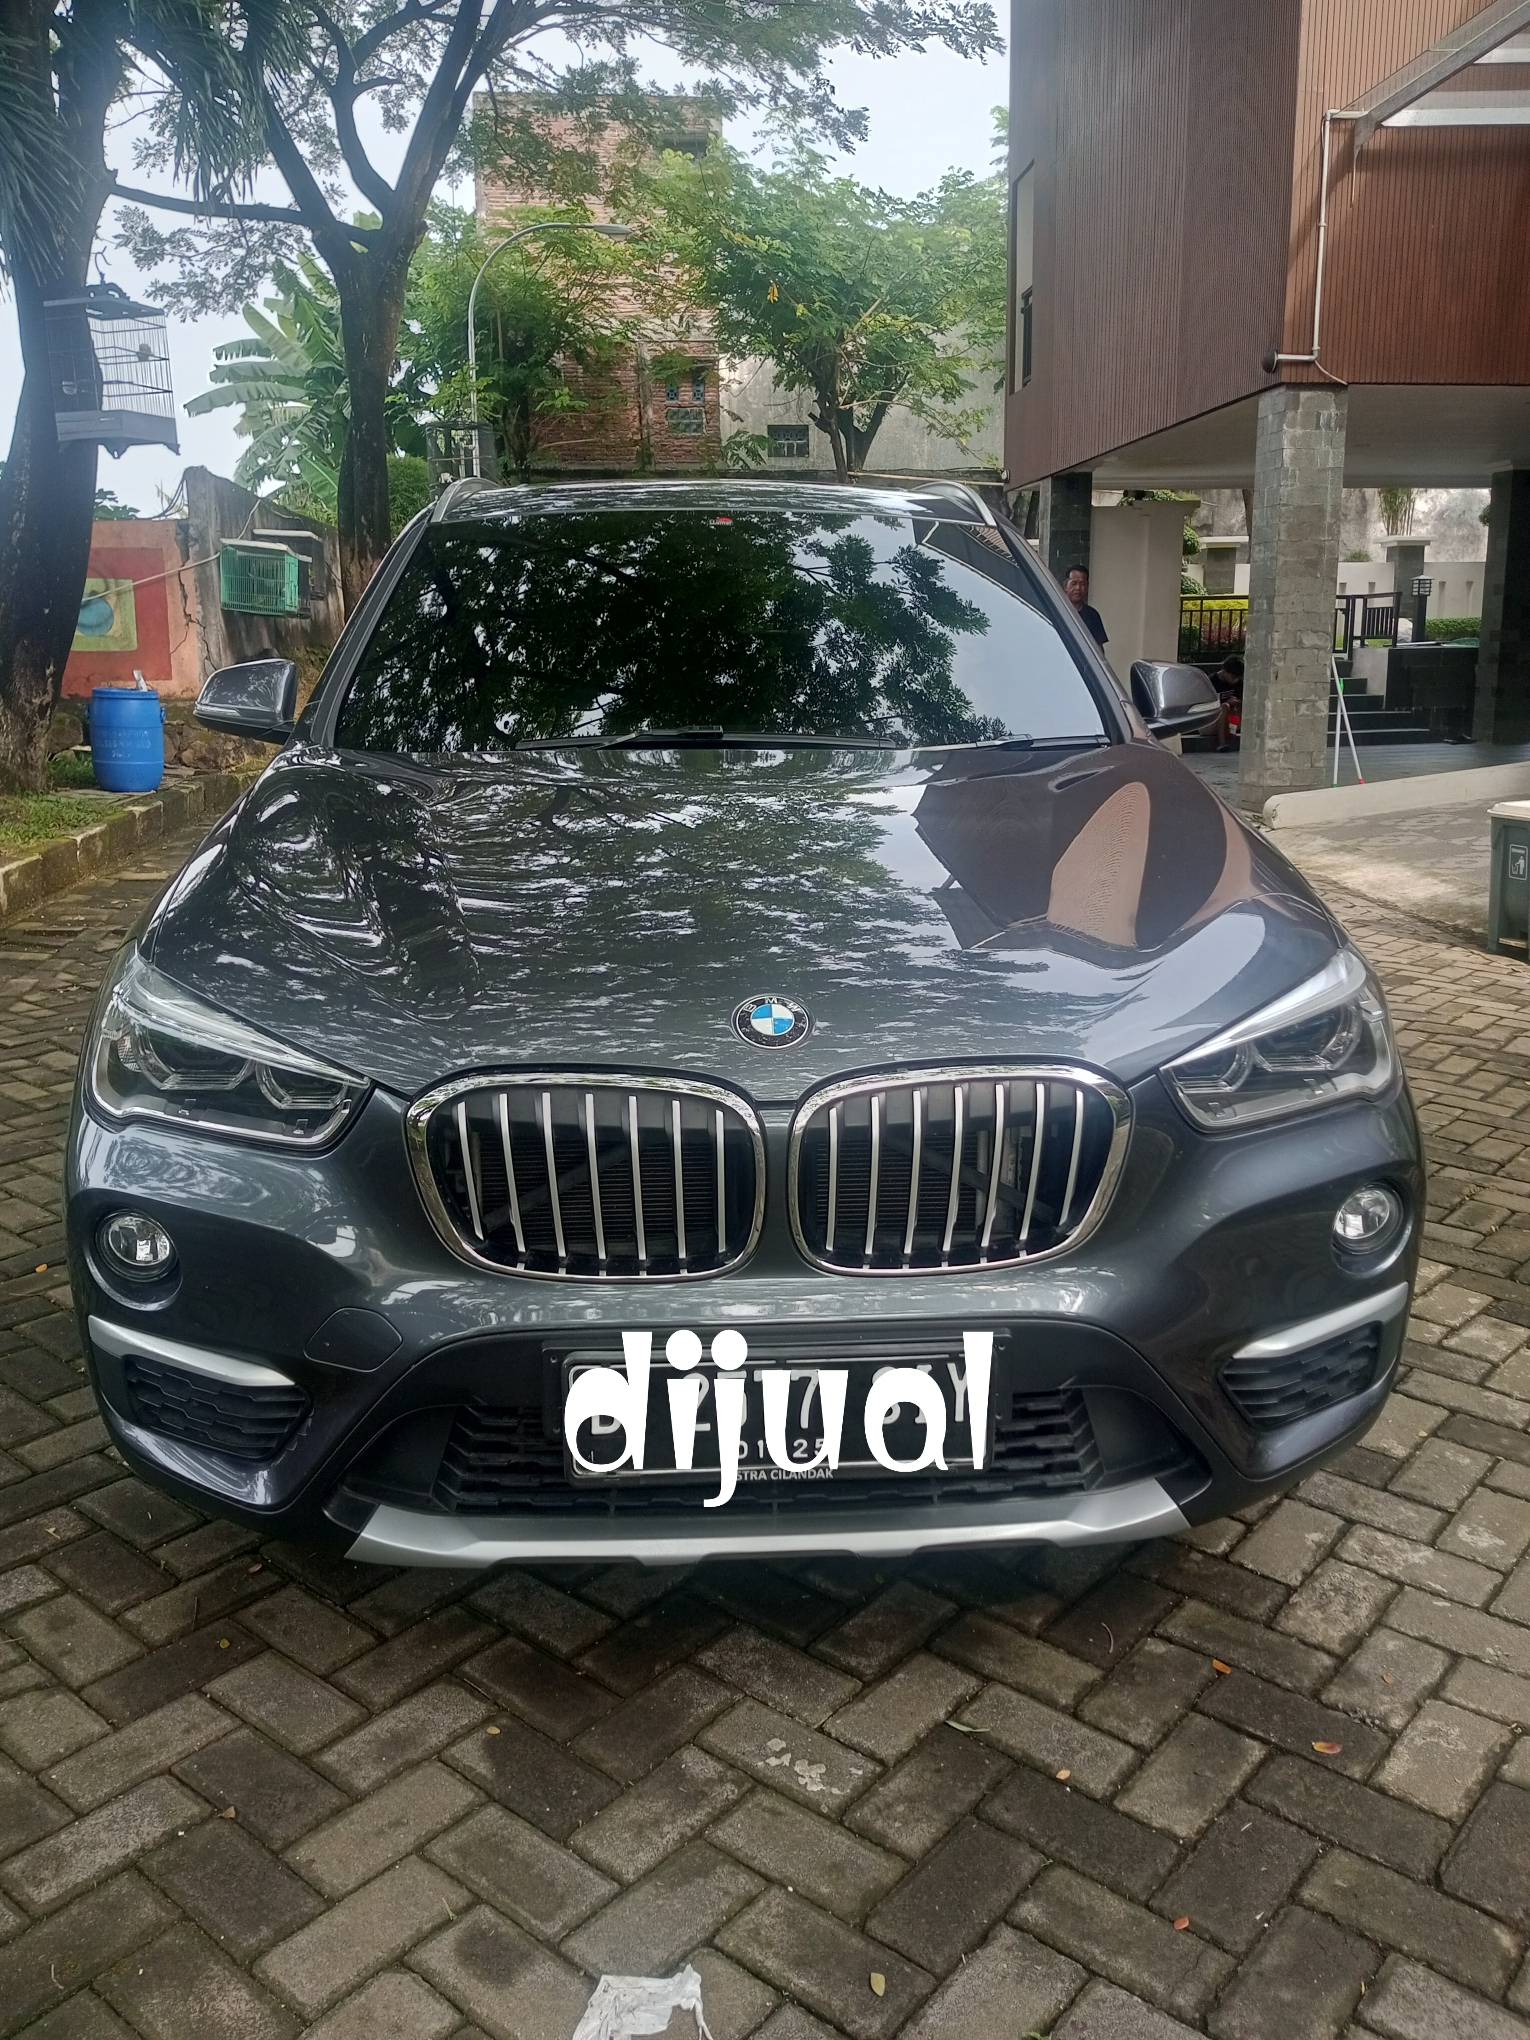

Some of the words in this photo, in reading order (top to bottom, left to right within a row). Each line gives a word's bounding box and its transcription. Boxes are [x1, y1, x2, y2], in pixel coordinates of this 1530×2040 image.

[744, 996, 801, 1012] BMW
[737, 1469, 768, 1481] STRA
[770, 1468, 834, 1480] CILANDAK
